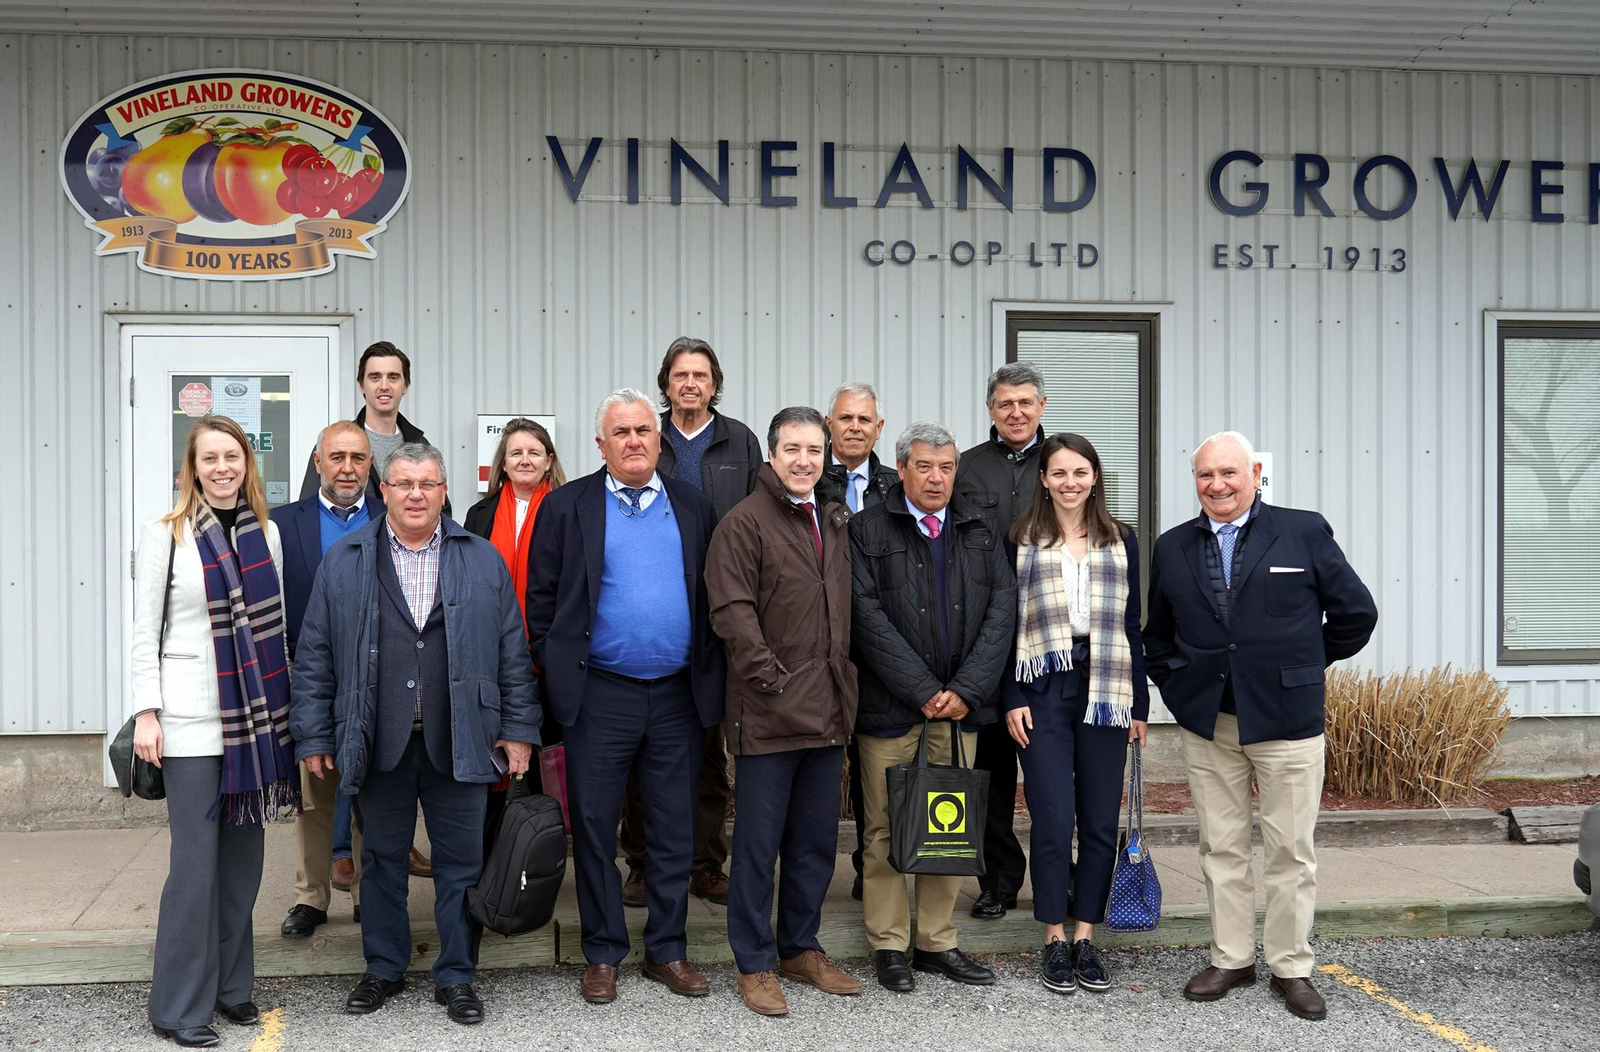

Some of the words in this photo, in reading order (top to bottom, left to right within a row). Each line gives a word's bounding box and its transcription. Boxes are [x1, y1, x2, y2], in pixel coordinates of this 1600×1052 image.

[116, 82, 233, 125] VINELAND
[240, 83, 355, 129] GROWERS
[545, 135, 1097, 214] VINELAND
[1208, 150, 1600, 224] GROWE
[121, 225, 144, 238] 1913
[328, 227, 353, 240] 2013
[185, 251, 221, 269] 100
[227, 251, 292, 270] YEARS
[1029, 242, 1099, 268] LTD
[1213, 244, 1297, 270] EST.
[1323, 246, 1407, 273] 1913
